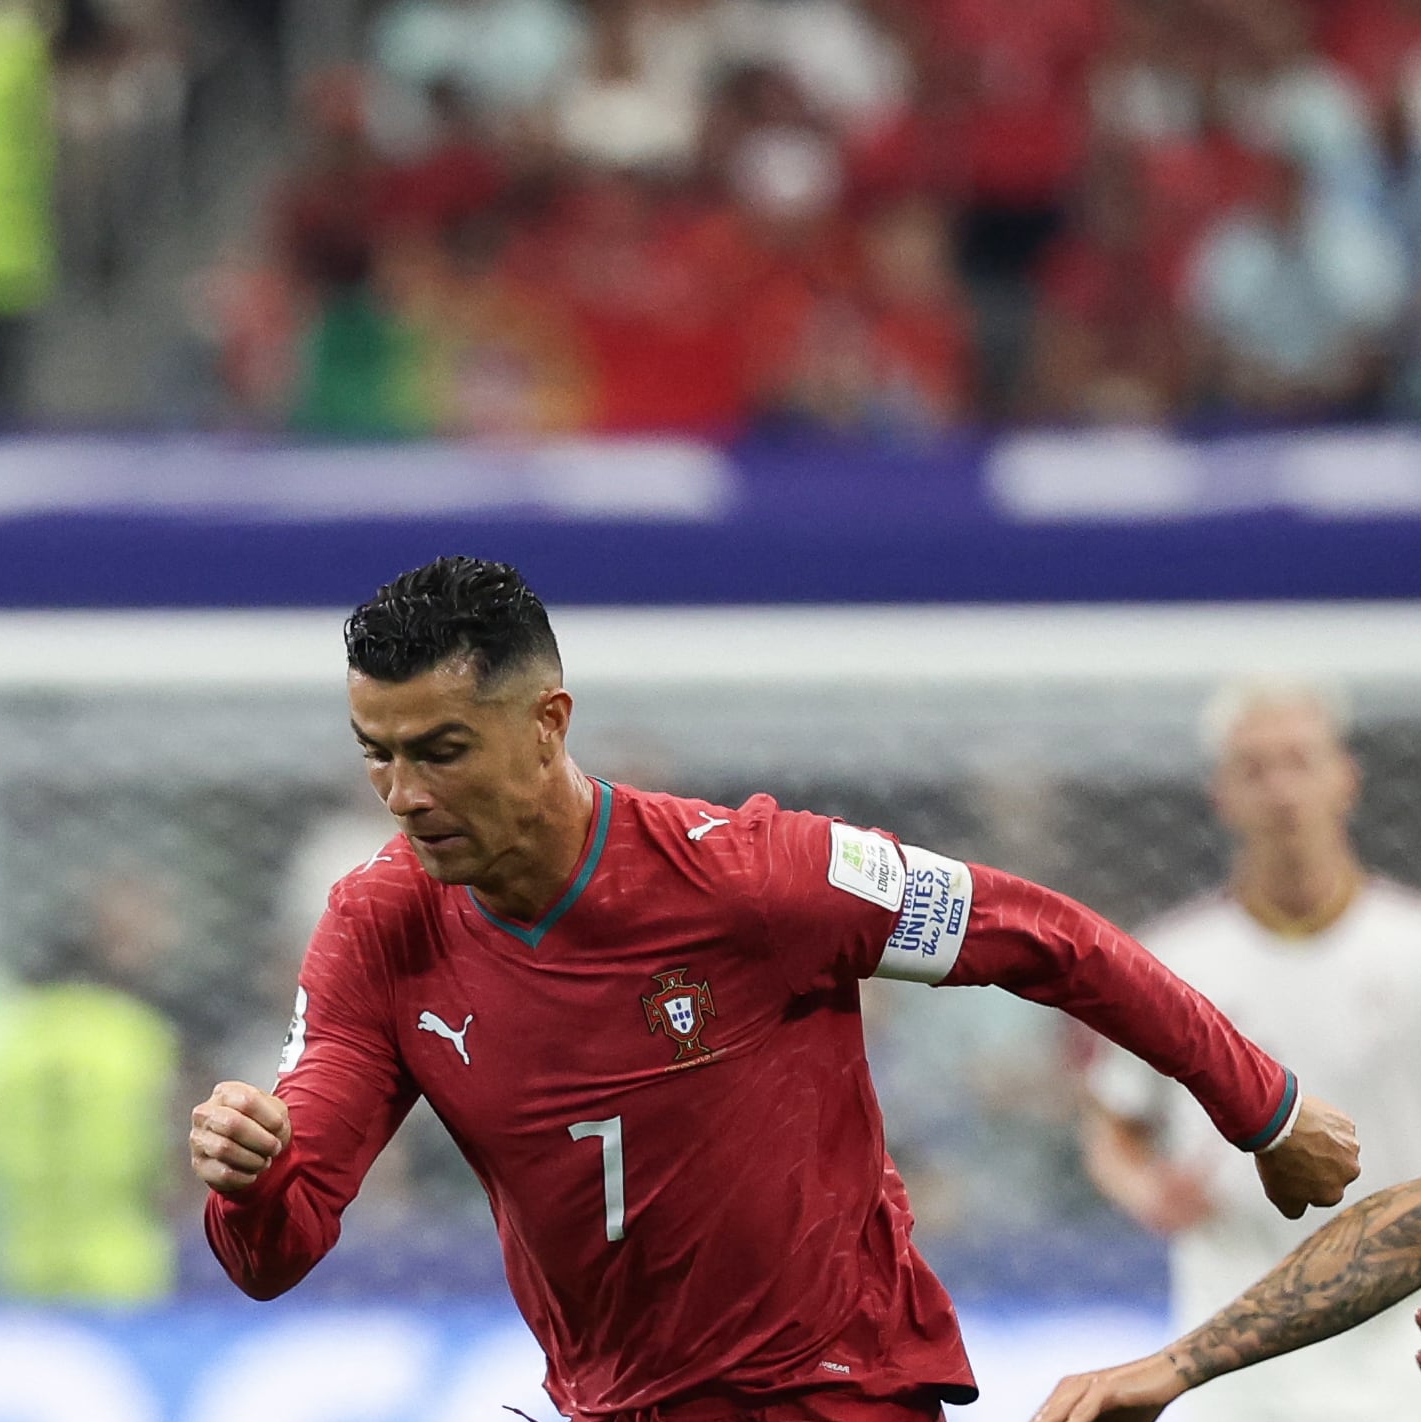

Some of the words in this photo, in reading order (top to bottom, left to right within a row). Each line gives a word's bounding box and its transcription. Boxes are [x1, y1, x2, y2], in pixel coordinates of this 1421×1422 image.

[900, 870, 934, 951] UNITES
[929, 867, 952, 925] World
[947, 900, 964, 934] FIFA
[921, 926, 941, 958] the
[567, 1115, 625, 1242] 7
